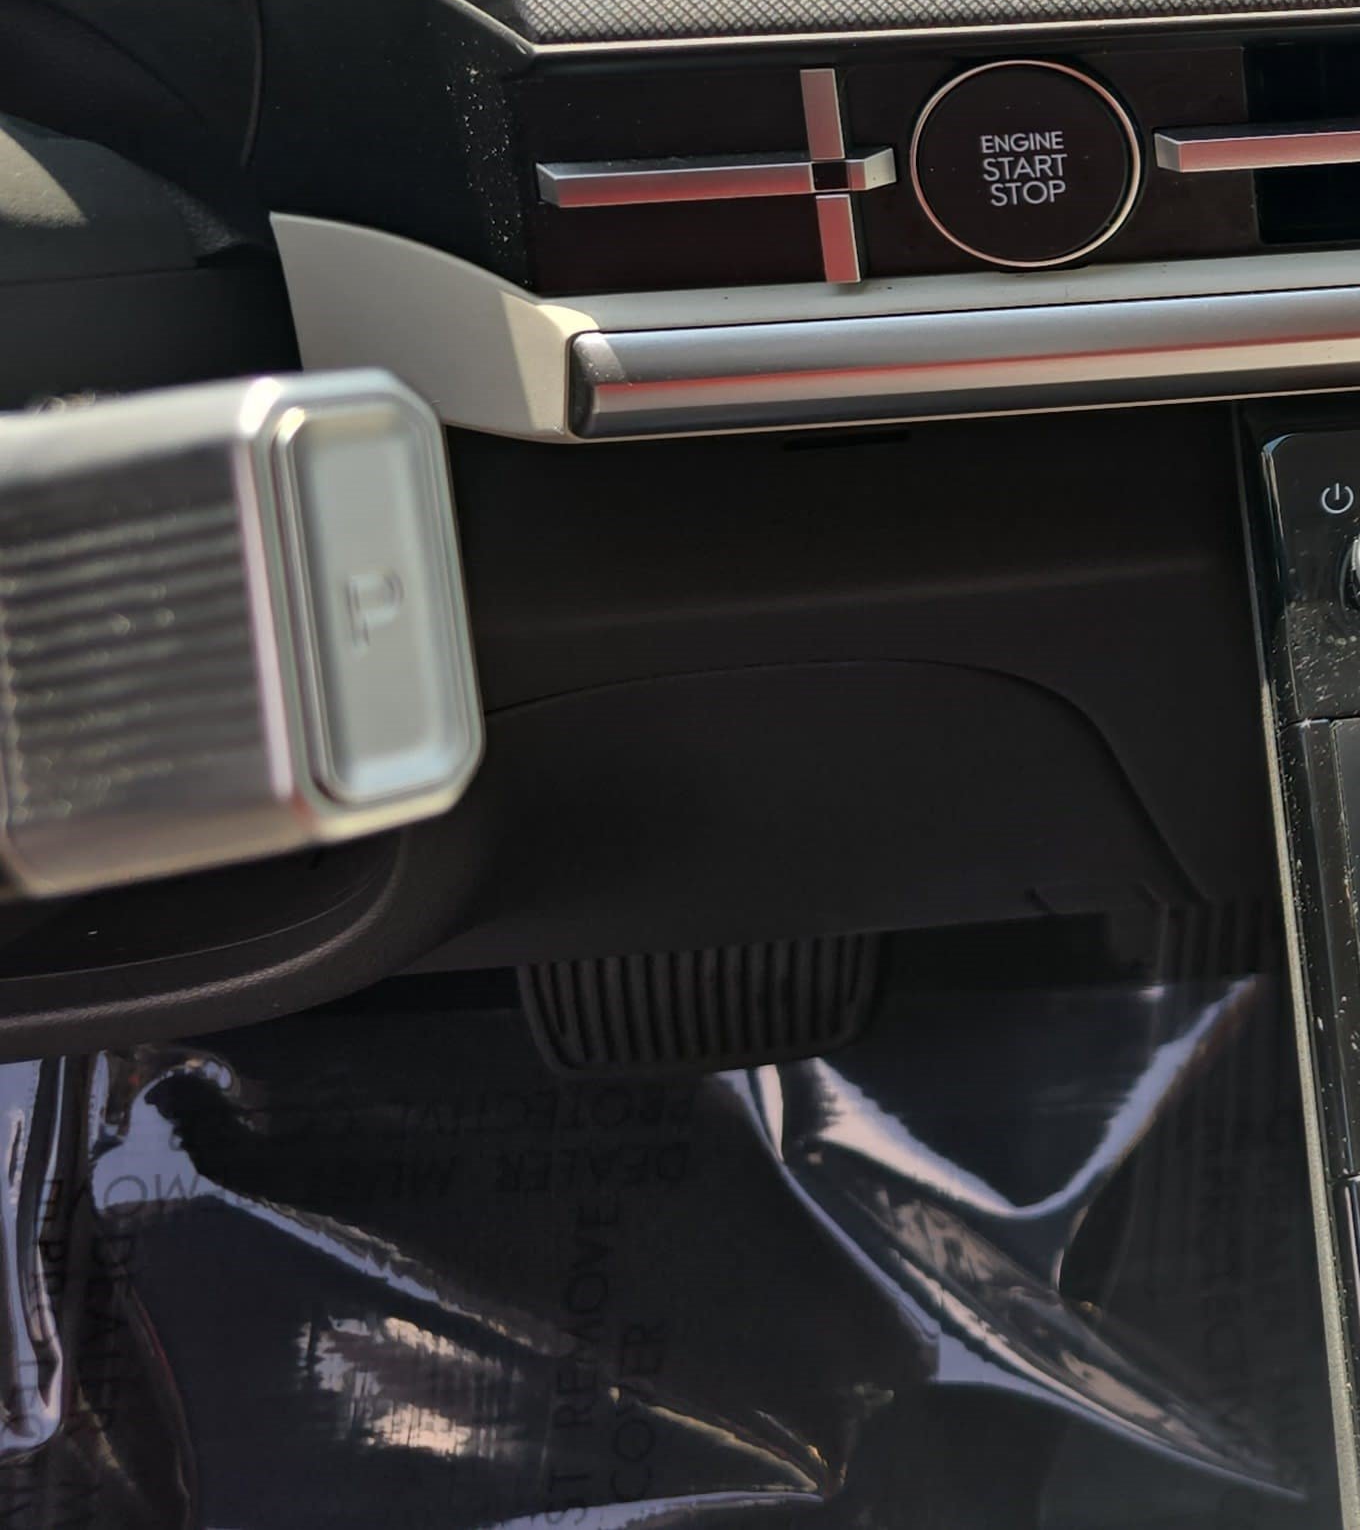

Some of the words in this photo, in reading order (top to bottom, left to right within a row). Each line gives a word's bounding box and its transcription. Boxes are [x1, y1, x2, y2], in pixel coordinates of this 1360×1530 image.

[979, 130, 1065, 155] ENGINE
[983, 153, 1069, 182] START
[989, 180, 1067, 207] STOP
